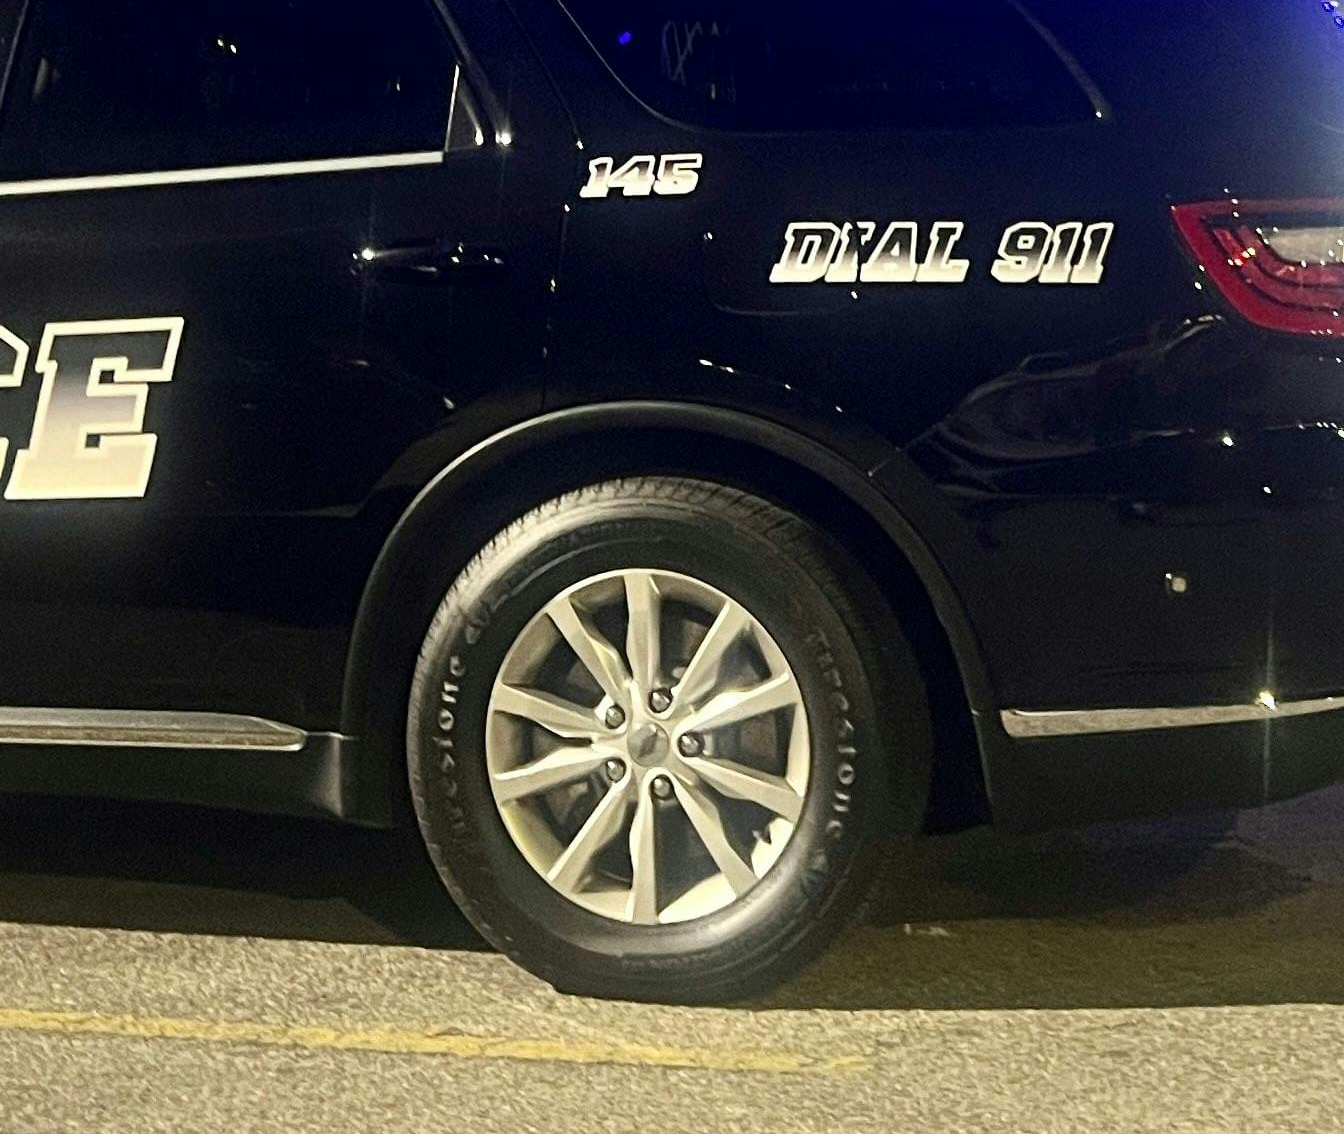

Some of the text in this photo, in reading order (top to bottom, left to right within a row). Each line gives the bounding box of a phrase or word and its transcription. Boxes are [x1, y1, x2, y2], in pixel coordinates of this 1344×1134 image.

[579, 153, 702, 198] 145
[769, 222, 1114, 284] DIAL 911
